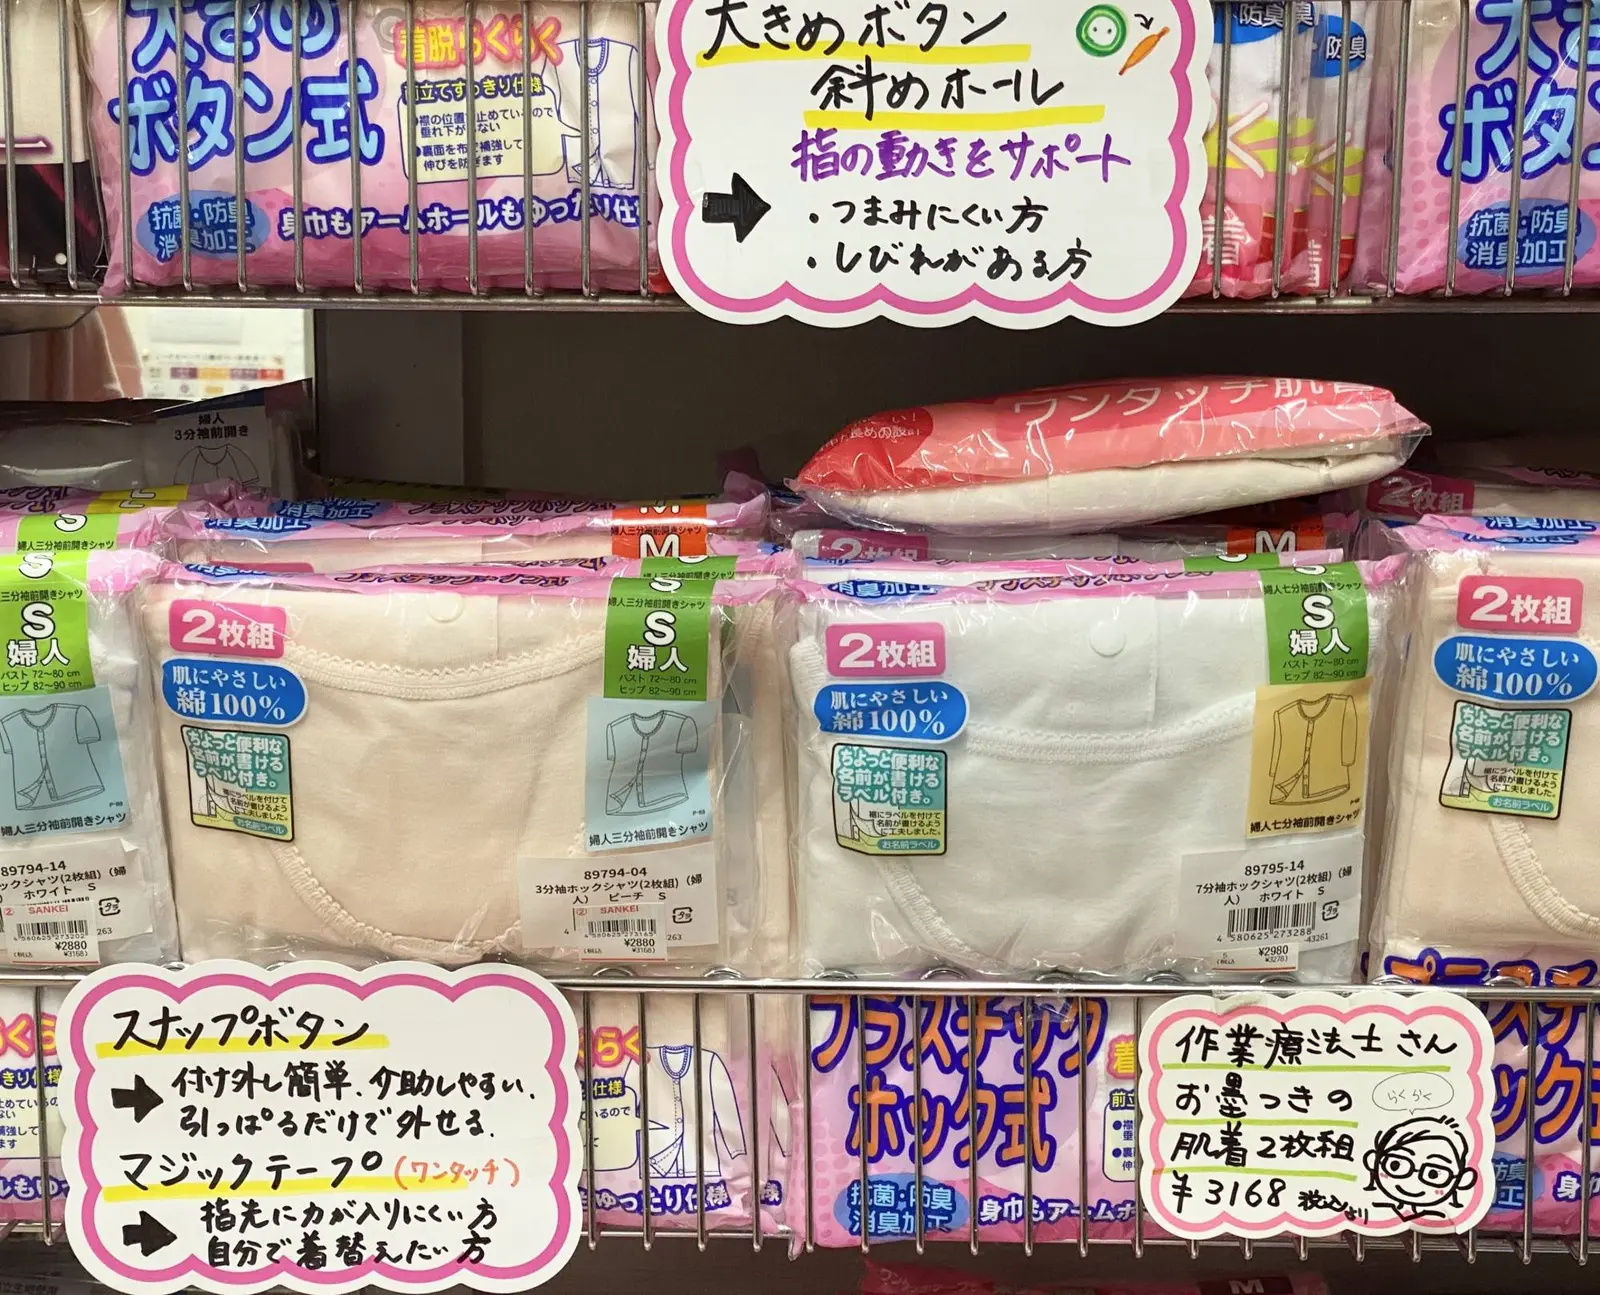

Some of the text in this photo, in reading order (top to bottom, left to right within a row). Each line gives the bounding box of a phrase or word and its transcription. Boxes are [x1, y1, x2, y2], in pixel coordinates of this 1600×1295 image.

[811, 55, 1064, 121] 斜めホール
[108, 58, 385, 175] ボタン式
[791, 128, 1131, 183] 指の動きをサポート
[1302, 594, 1335, 629] S
[1470, 585, 1572, 625] 2枚組
[21, 602, 56, 640] S
[182, 609, 275, 650] 2枚組
[643, 610, 677, 646] S
[7, 638, 70, 668] 婦人
[839, 632, 937, 669] 2枚組
[1289, 628, 1350, 656] 婦人
[1455, 642, 1580, 669] 肌にやさしい
[627, 645, 689, 673] 婦人
[172, 665, 287, 691] 肌にやさしい
[1456, 665, 1573, 697] 綿100%
[176, 688, 286, 721] 綿100%
[830, 689, 949, 710] 肌にやさしい
[832, 709, 946, 736] 綿100%
[1462, 705, 1563, 731] ちょっと便利な
[188, 729, 283, 756] ちょっと便利な
[839, 749, 940, 771] ちょっと便利な
[1493, 798, 1551, 813] お名前ラベル
[1, 812, 127, 837] 婦人三分袖前開きシャツ
[589, 821, 709, 847] 婦人三分袖前開きシャツ
[1250, 808, 1361, 833] 婦人七分袖前開きシャツ
[881, 838, 937, 850] お名前ラベル
[0, 860, 67, 877] 89794-14
[583, 867, 648, 880] 89794-04
[1244, 860, 1305, 876] 89795-14
[23, 882, 97, 900] ホワイト S
[658, 892, 667, 901] S
[1259, 888, 1304, 903] ホワイト
[1317, 886, 1325, 896] S
[28, 904, 69, 915] SANKEI
[600, 905, 639, 914] SANKEI
[55, 940, 88, 950] ¥2880
[624, 938, 655, 947] ¥2880
[1258, 945, 1289, 956] ¥2980
[111, 1005, 370, 1051] スナップボタン
[1175, 1021, 1458, 1069] 作業療法士さん
[1175, 1071, 1354, 1118] お墨つきの
[847, 1071, 1057, 1171] ホック式
[1170, 1120, 1355, 1168] 肌着2枚組
[119, 1150, 383, 1191] マジックテープ
[1171, 1170, 1287, 1213] ¥3168
[199, 1197, 499, 1234] 指先に力が入りにくい方
[207, 1229, 489, 1269] 自分で着替えたい方
